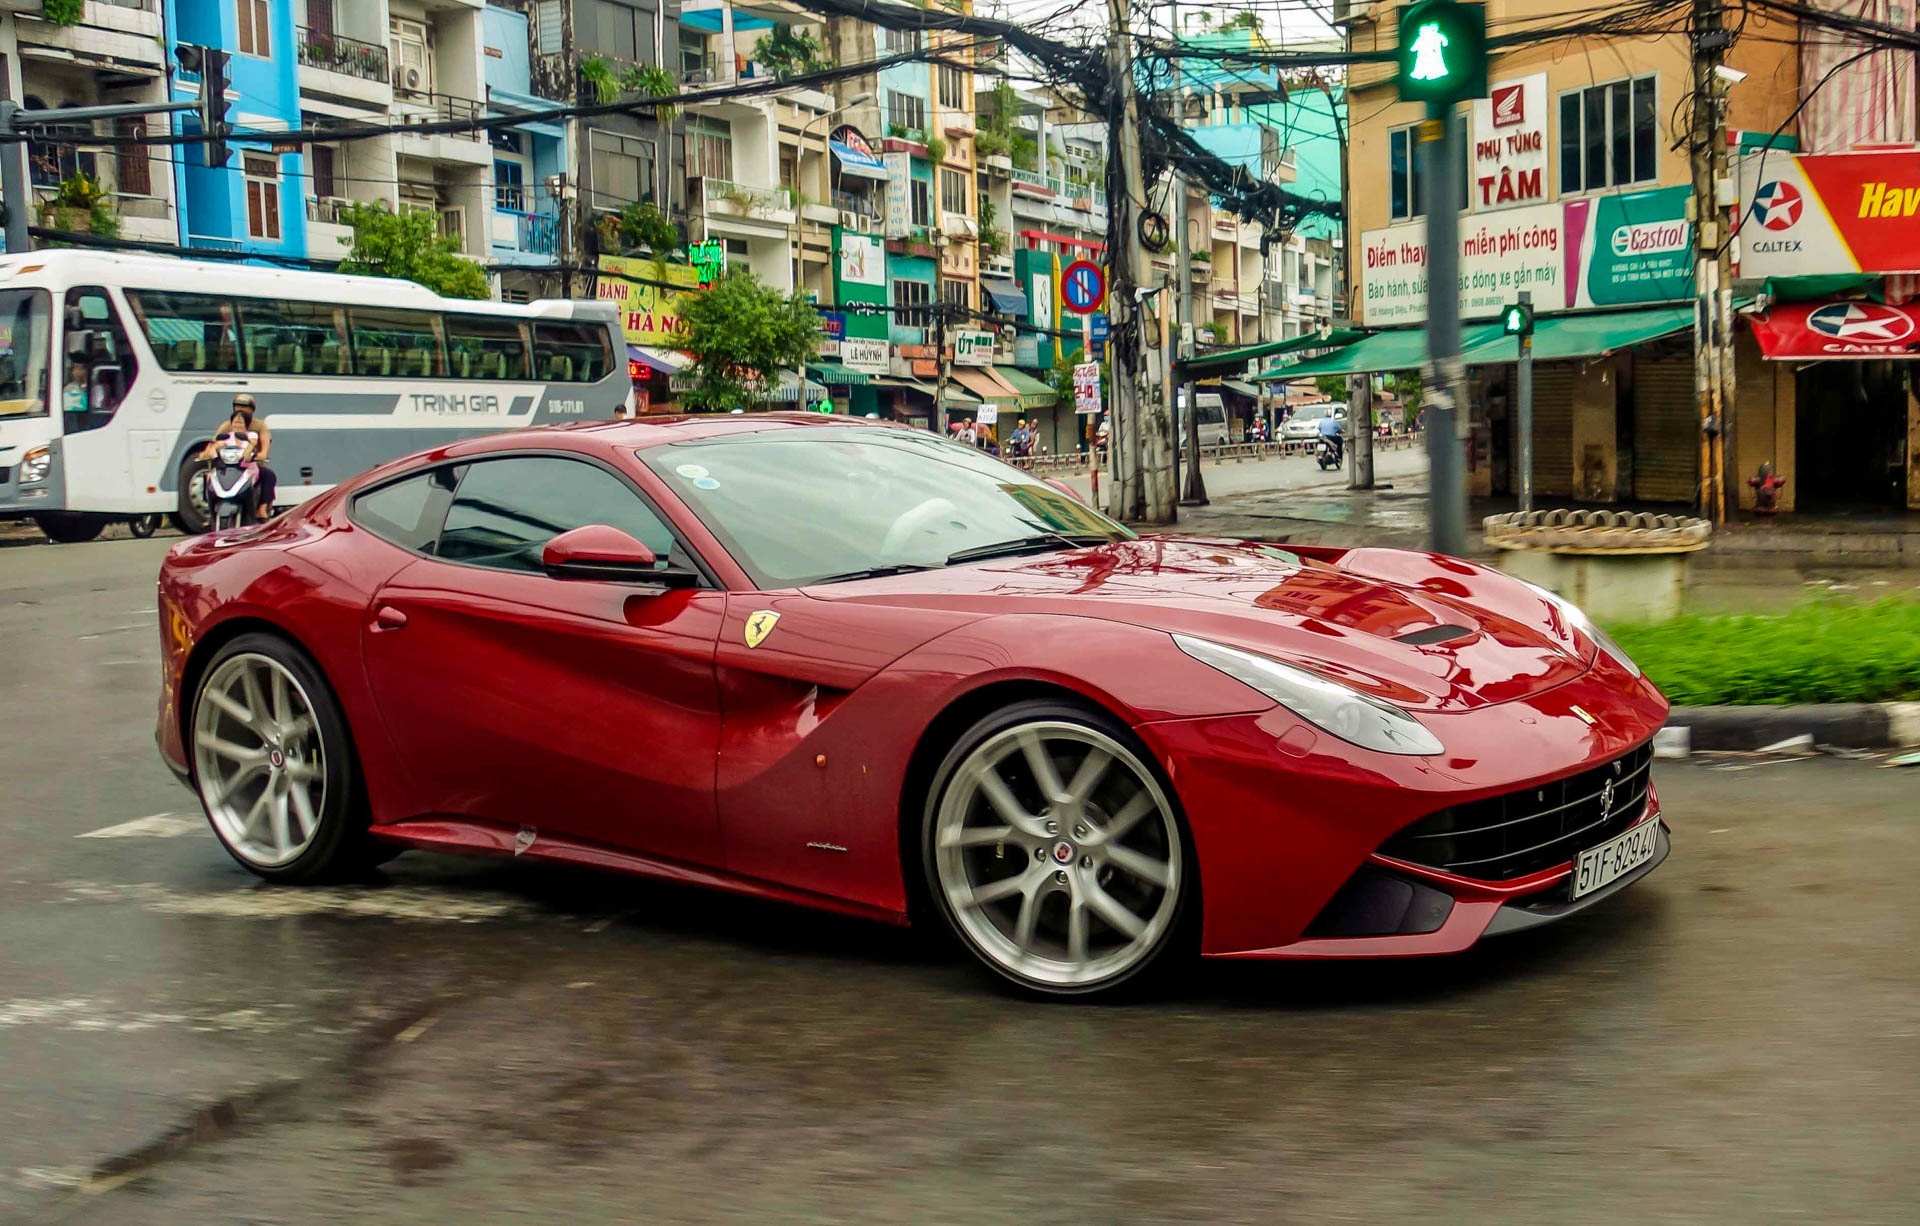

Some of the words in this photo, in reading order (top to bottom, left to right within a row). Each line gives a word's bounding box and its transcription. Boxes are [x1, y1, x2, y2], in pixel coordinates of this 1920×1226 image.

[1477, 138, 1501, 163] PHỤ
[1506, 129, 1542, 156] TÙNG
[1478, 165, 1542, 206] TÂM
[1368, 237, 1397, 269] Điểm
[1401, 243, 1427, 268] thay
[1464, 226, 1497, 258] miễn
[1500, 226, 1520, 257] phí
[1523, 224, 1558, 252] công
[1631, 223, 1685, 251] Castrol
[1752, 240, 1802, 254] CALTEX
[1457, 274, 1470, 291] ác
[1472, 270, 1497, 292] dòng
[1500, 271, 1511, 286] xe
[1535, 263, 1558, 287] máy
[627, 308, 655, 333] HÀ
[958, 332, 974, 355] ÚT
[1579, 821, 1657, 892] 51F-829.40
